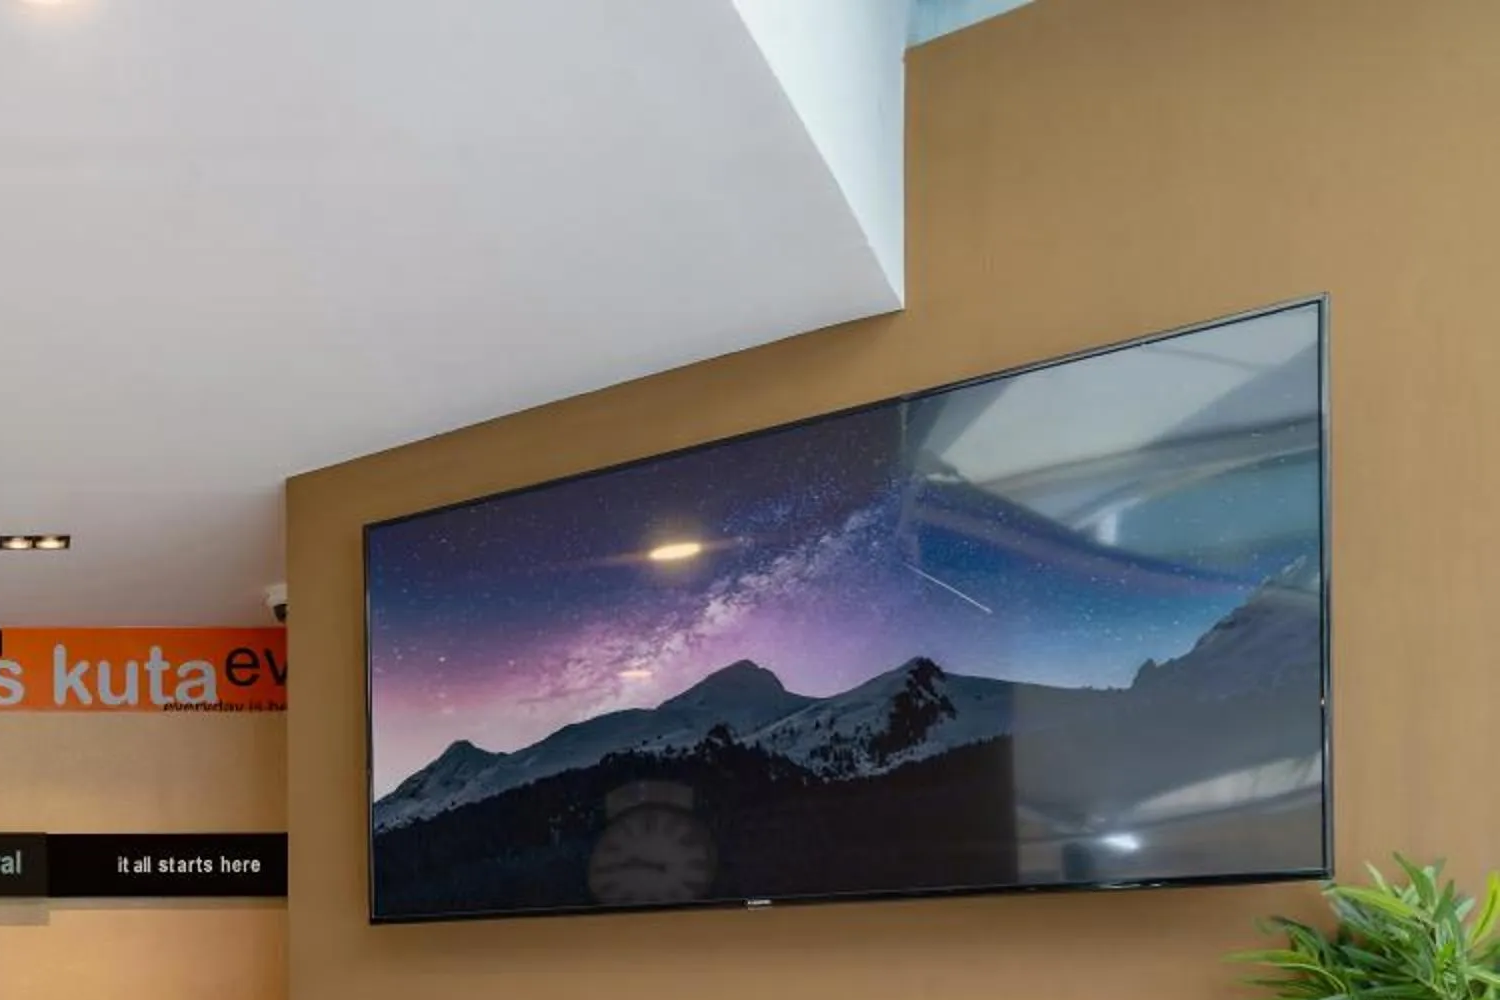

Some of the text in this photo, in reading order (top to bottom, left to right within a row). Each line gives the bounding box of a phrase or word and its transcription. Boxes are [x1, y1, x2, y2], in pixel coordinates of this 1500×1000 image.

[53, 643, 217, 705] kuta
[117, 855, 261, 873] it all starts here
